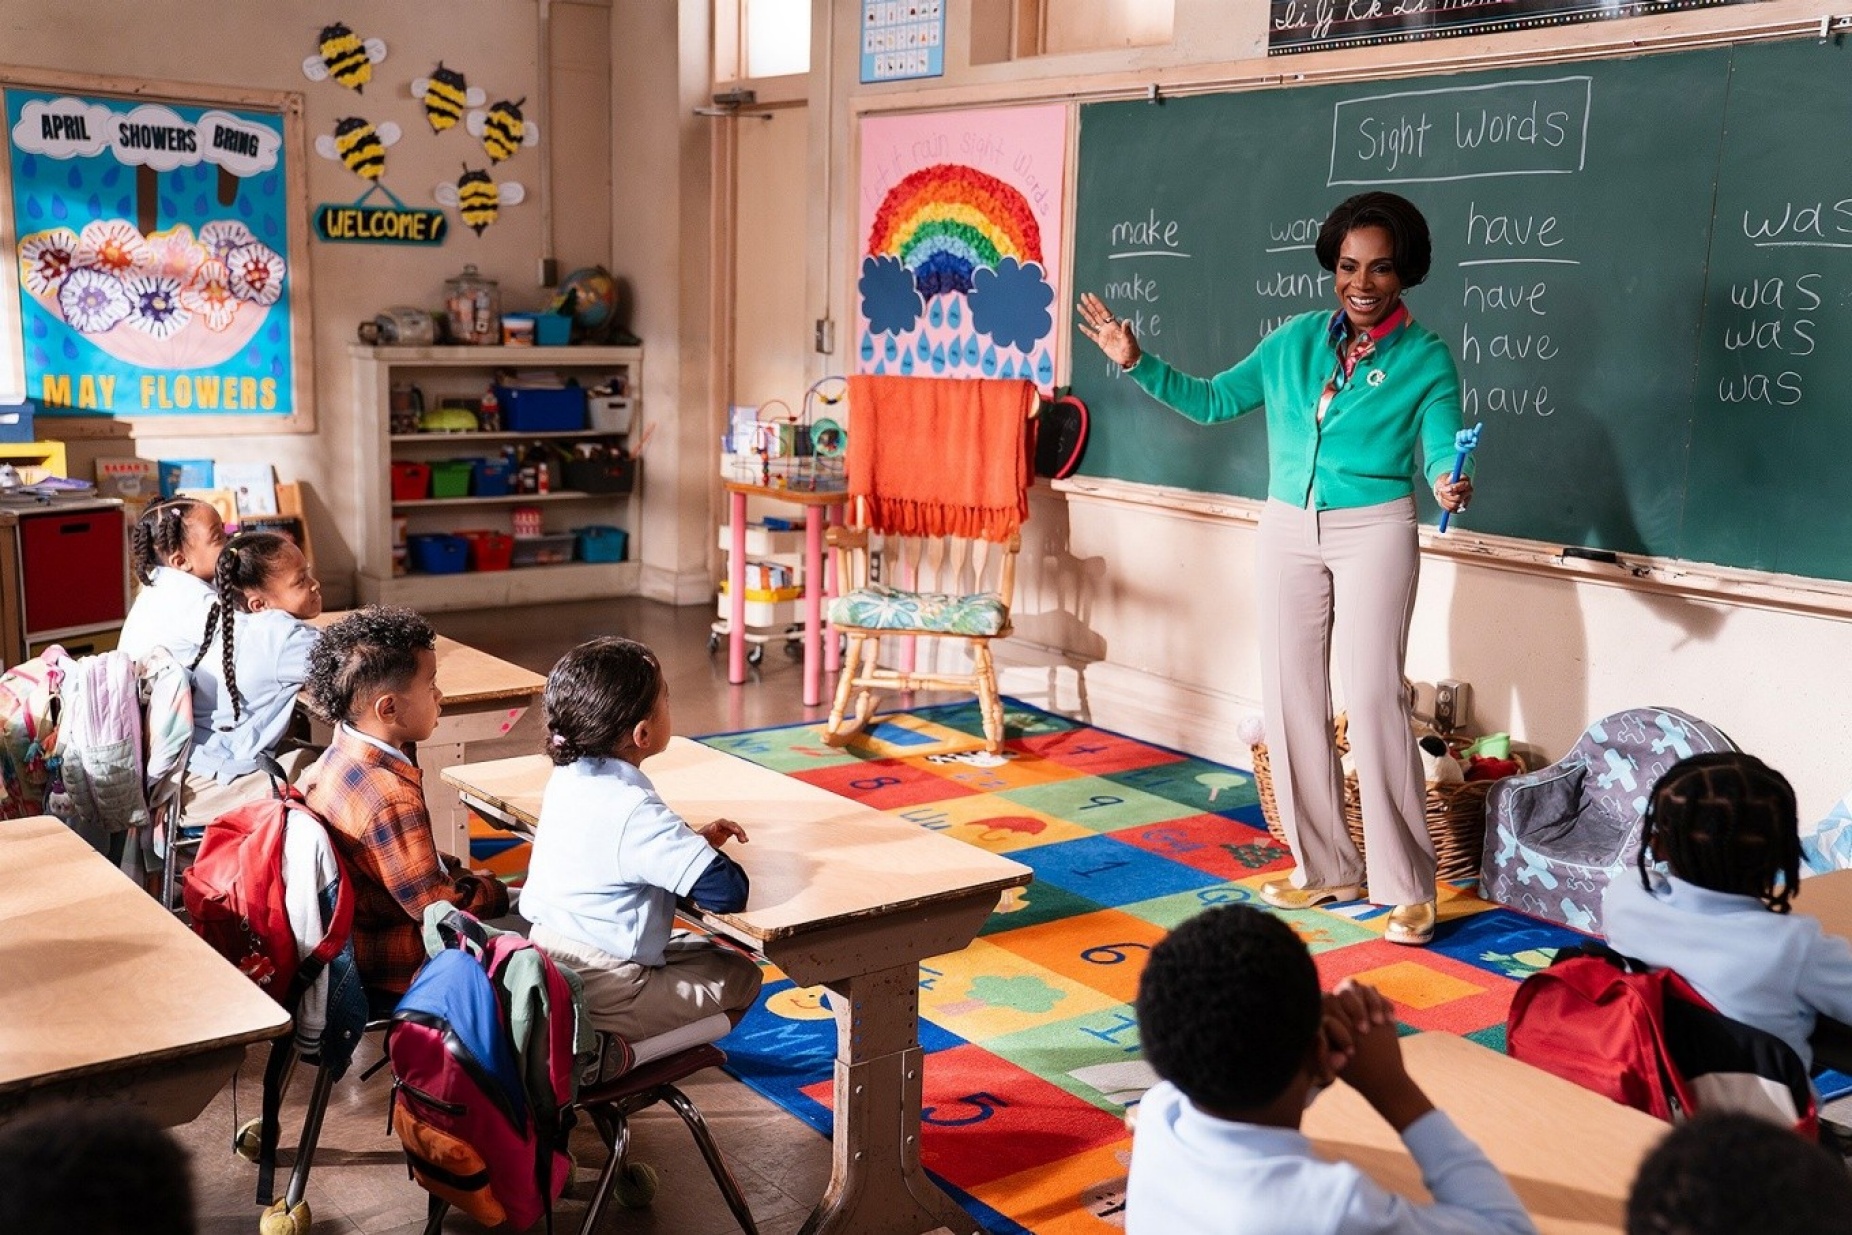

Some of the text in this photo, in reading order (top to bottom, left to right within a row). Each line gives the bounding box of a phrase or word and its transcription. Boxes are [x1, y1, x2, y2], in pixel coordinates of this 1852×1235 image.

[41, 114, 260, 158] APRIL SHOWERS BRING
[1358, 100, 1570, 173] Sight Words
[1111, 207, 1179, 248] make
[1467, 201, 1564, 247] have
[1743, 198, 1852, 239] was
[1105, 272, 1160, 302] make
[1255, 270, 1333, 299] want
[1463, 277, 1547, 316] have
[1731, 273, 1823, 311] was
[1463, 322, 1559, 365] have
[1724, 319, 1816, 356] was
[42, 374, 278, 410] MAY FLOWERS
[1462, 378, 1555, 417] have
[1719, 371, 1803, 406] was
[850, 776, 901, 790] 8
[1080, 942, 1150, 965] 6
[921, 1091, 1008, 1127] 5
